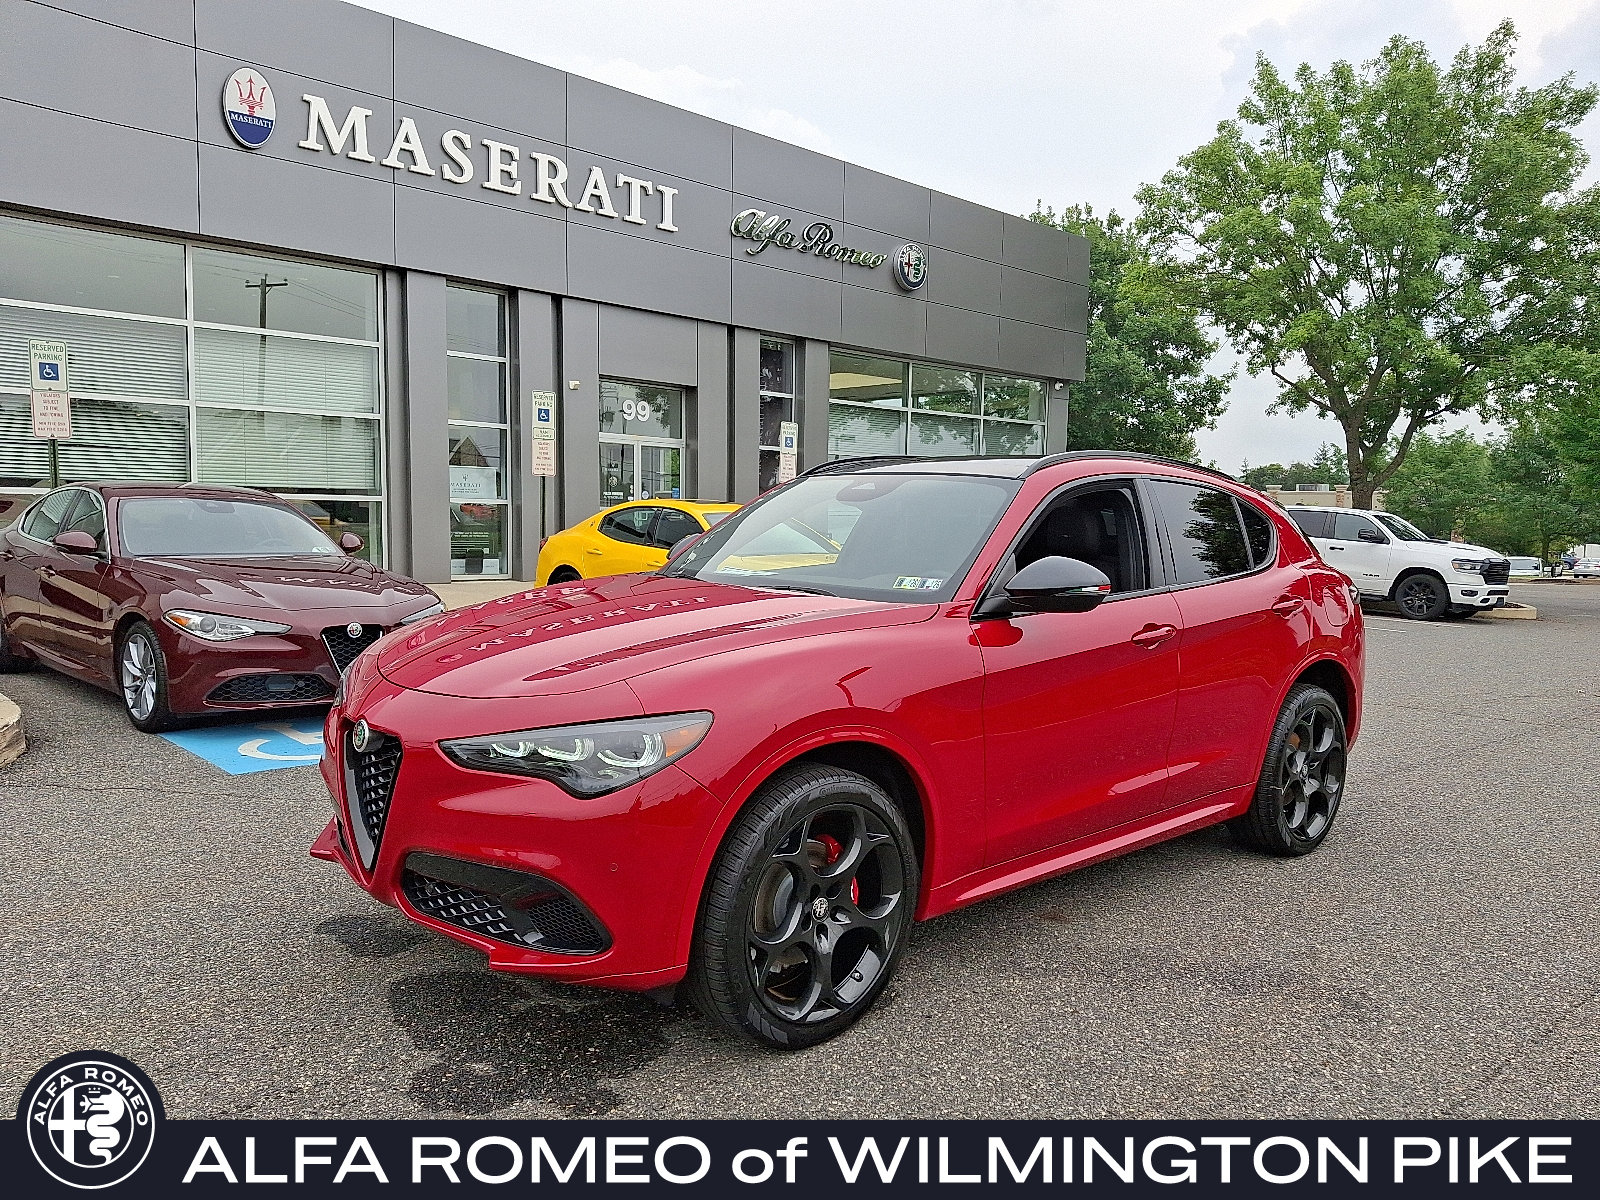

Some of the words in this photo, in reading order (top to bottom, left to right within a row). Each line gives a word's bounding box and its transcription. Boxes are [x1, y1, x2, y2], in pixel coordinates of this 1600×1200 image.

[230, 112, 272, 128] MASERATI
[298, 93, 679, 233] MASERATI
[731, 208, 799, 255] Alfa
[799, 222, 888, 268] Romeo
[31, 344, 64, 352] RESERVED
[34, 352, 62, 361] PARKING
[622, 400, 650, 421] 99
